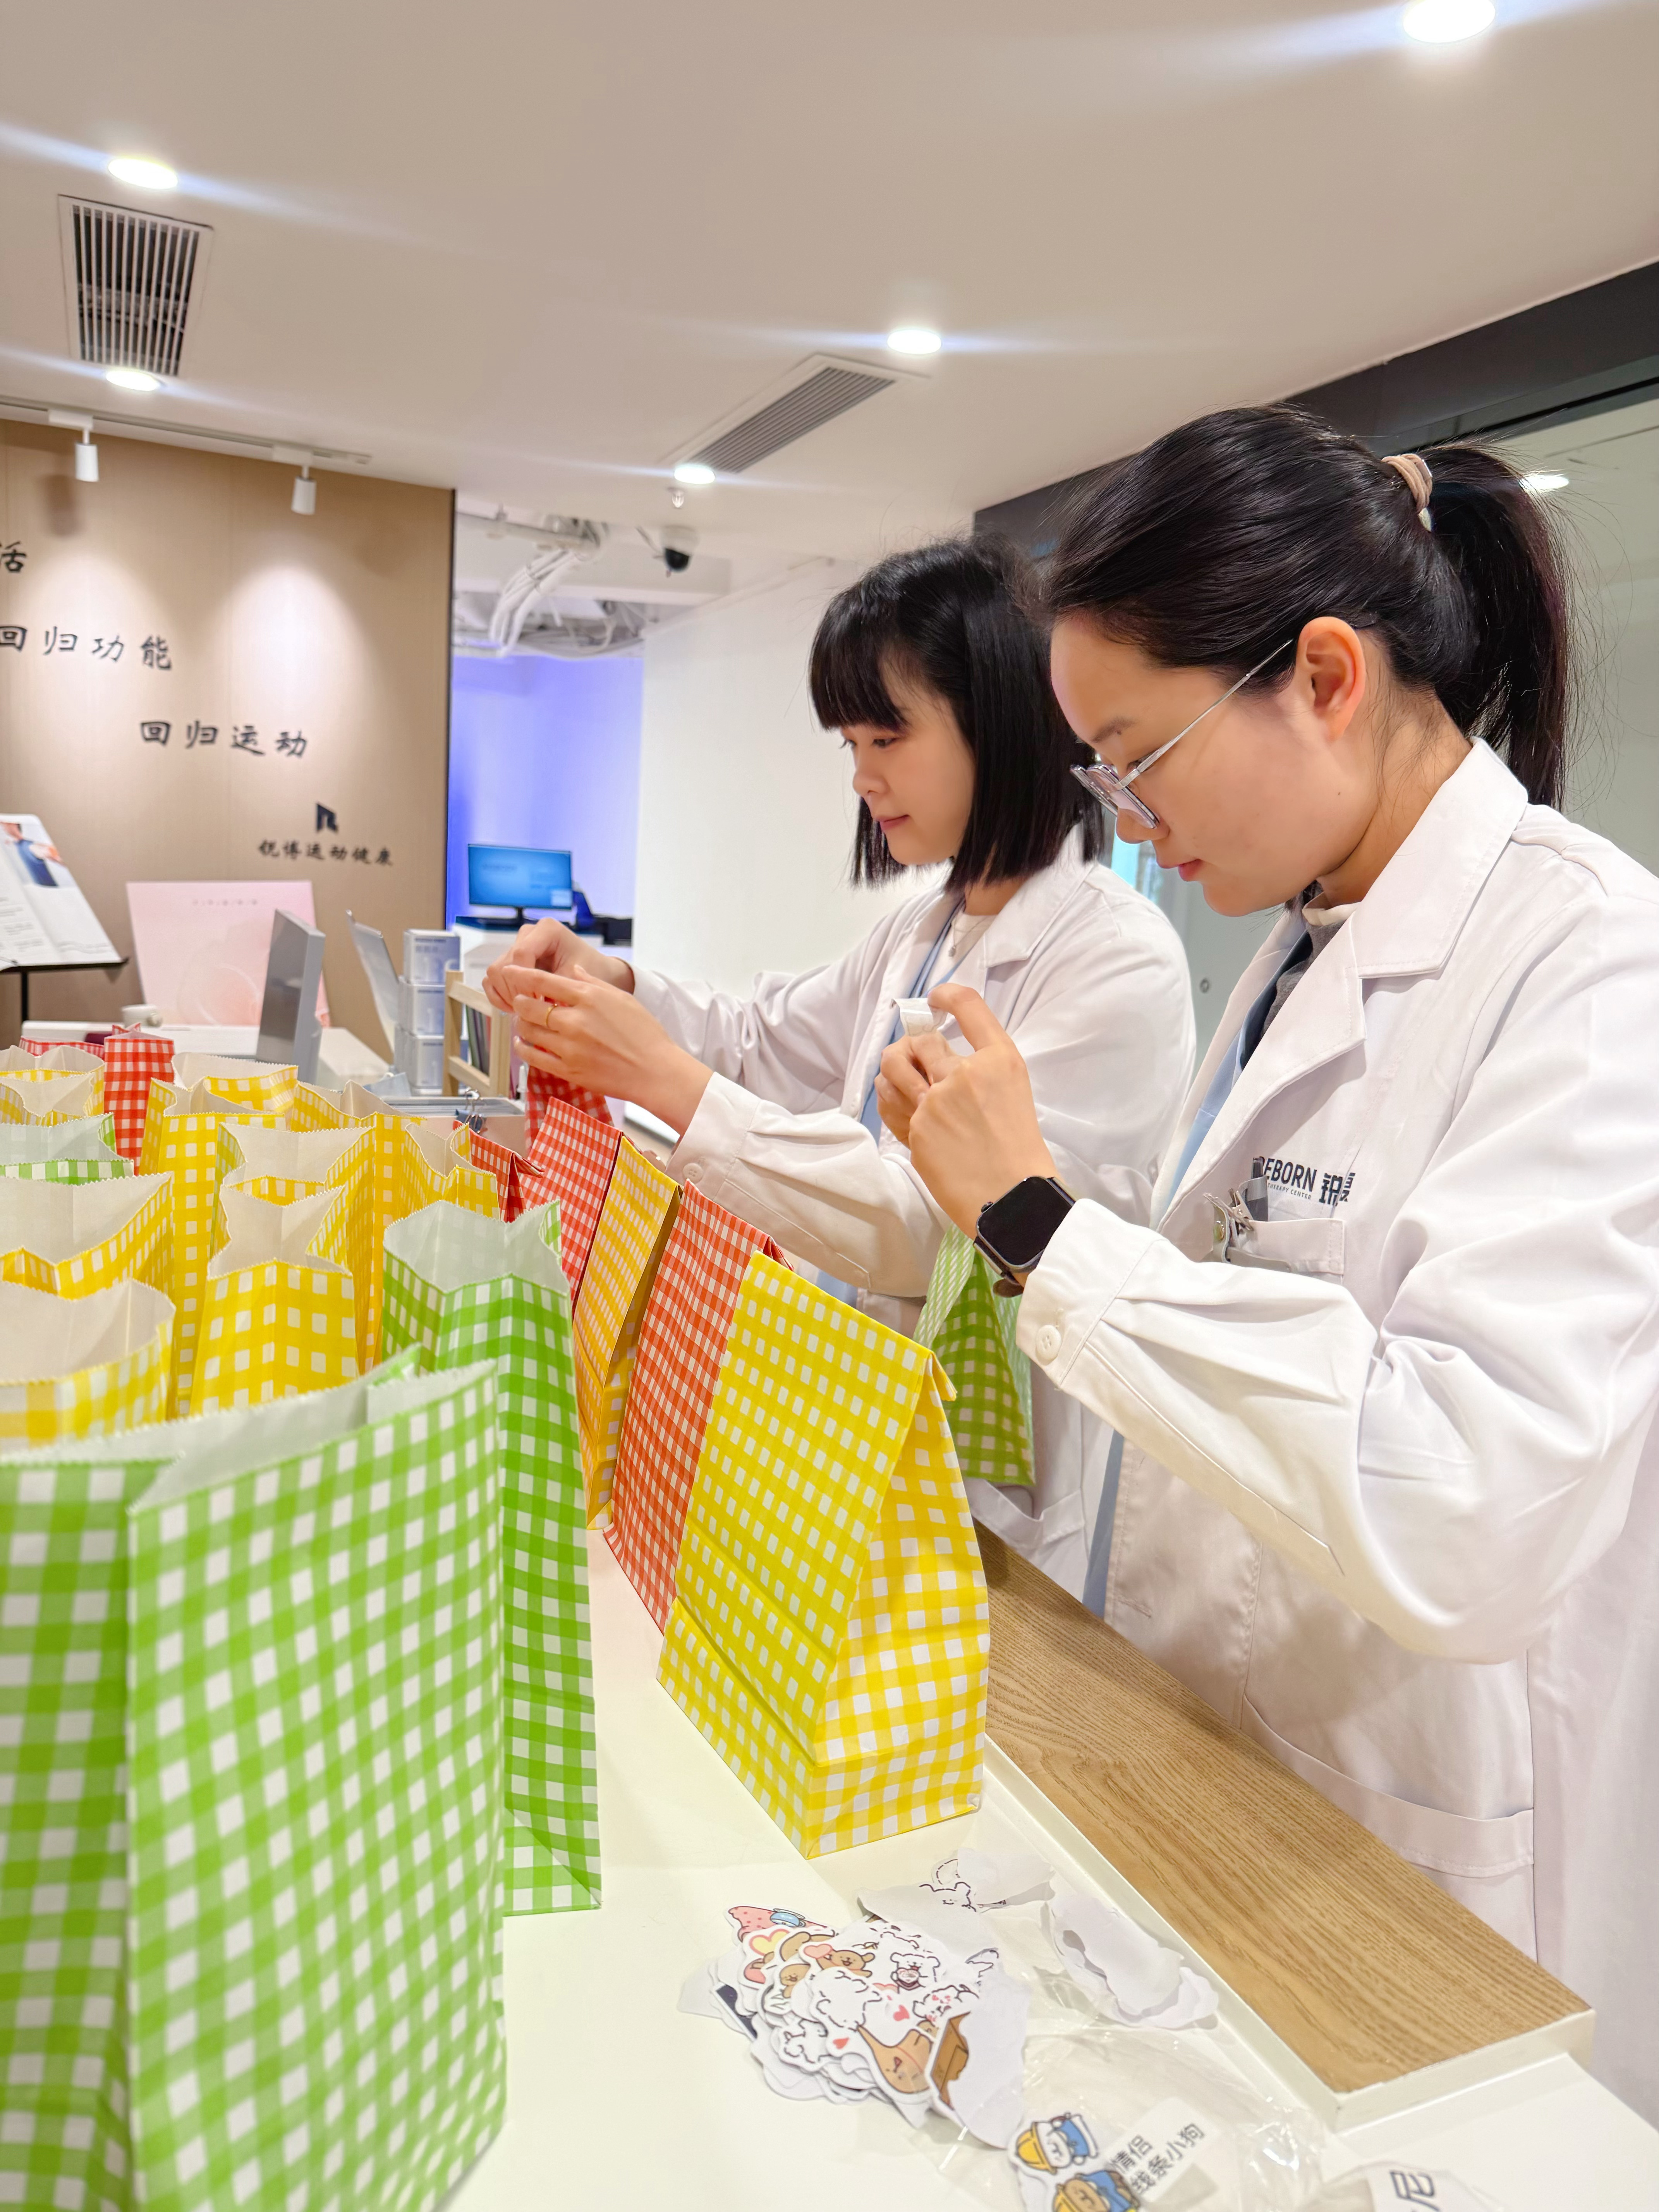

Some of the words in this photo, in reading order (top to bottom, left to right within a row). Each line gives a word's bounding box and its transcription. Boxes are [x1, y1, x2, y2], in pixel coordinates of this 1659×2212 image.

[0, 626, 172, 670] 回归功能
[141, 720, 307, 757] 回归运动
[258, 840, 393, 866] 锐博运动健康
[1290, 1189, 1312, 1200] CENTER
[1110, 2134, 1153, 2174] 情侣
[1130, 2123, 1205, 2195] 线条小狗
